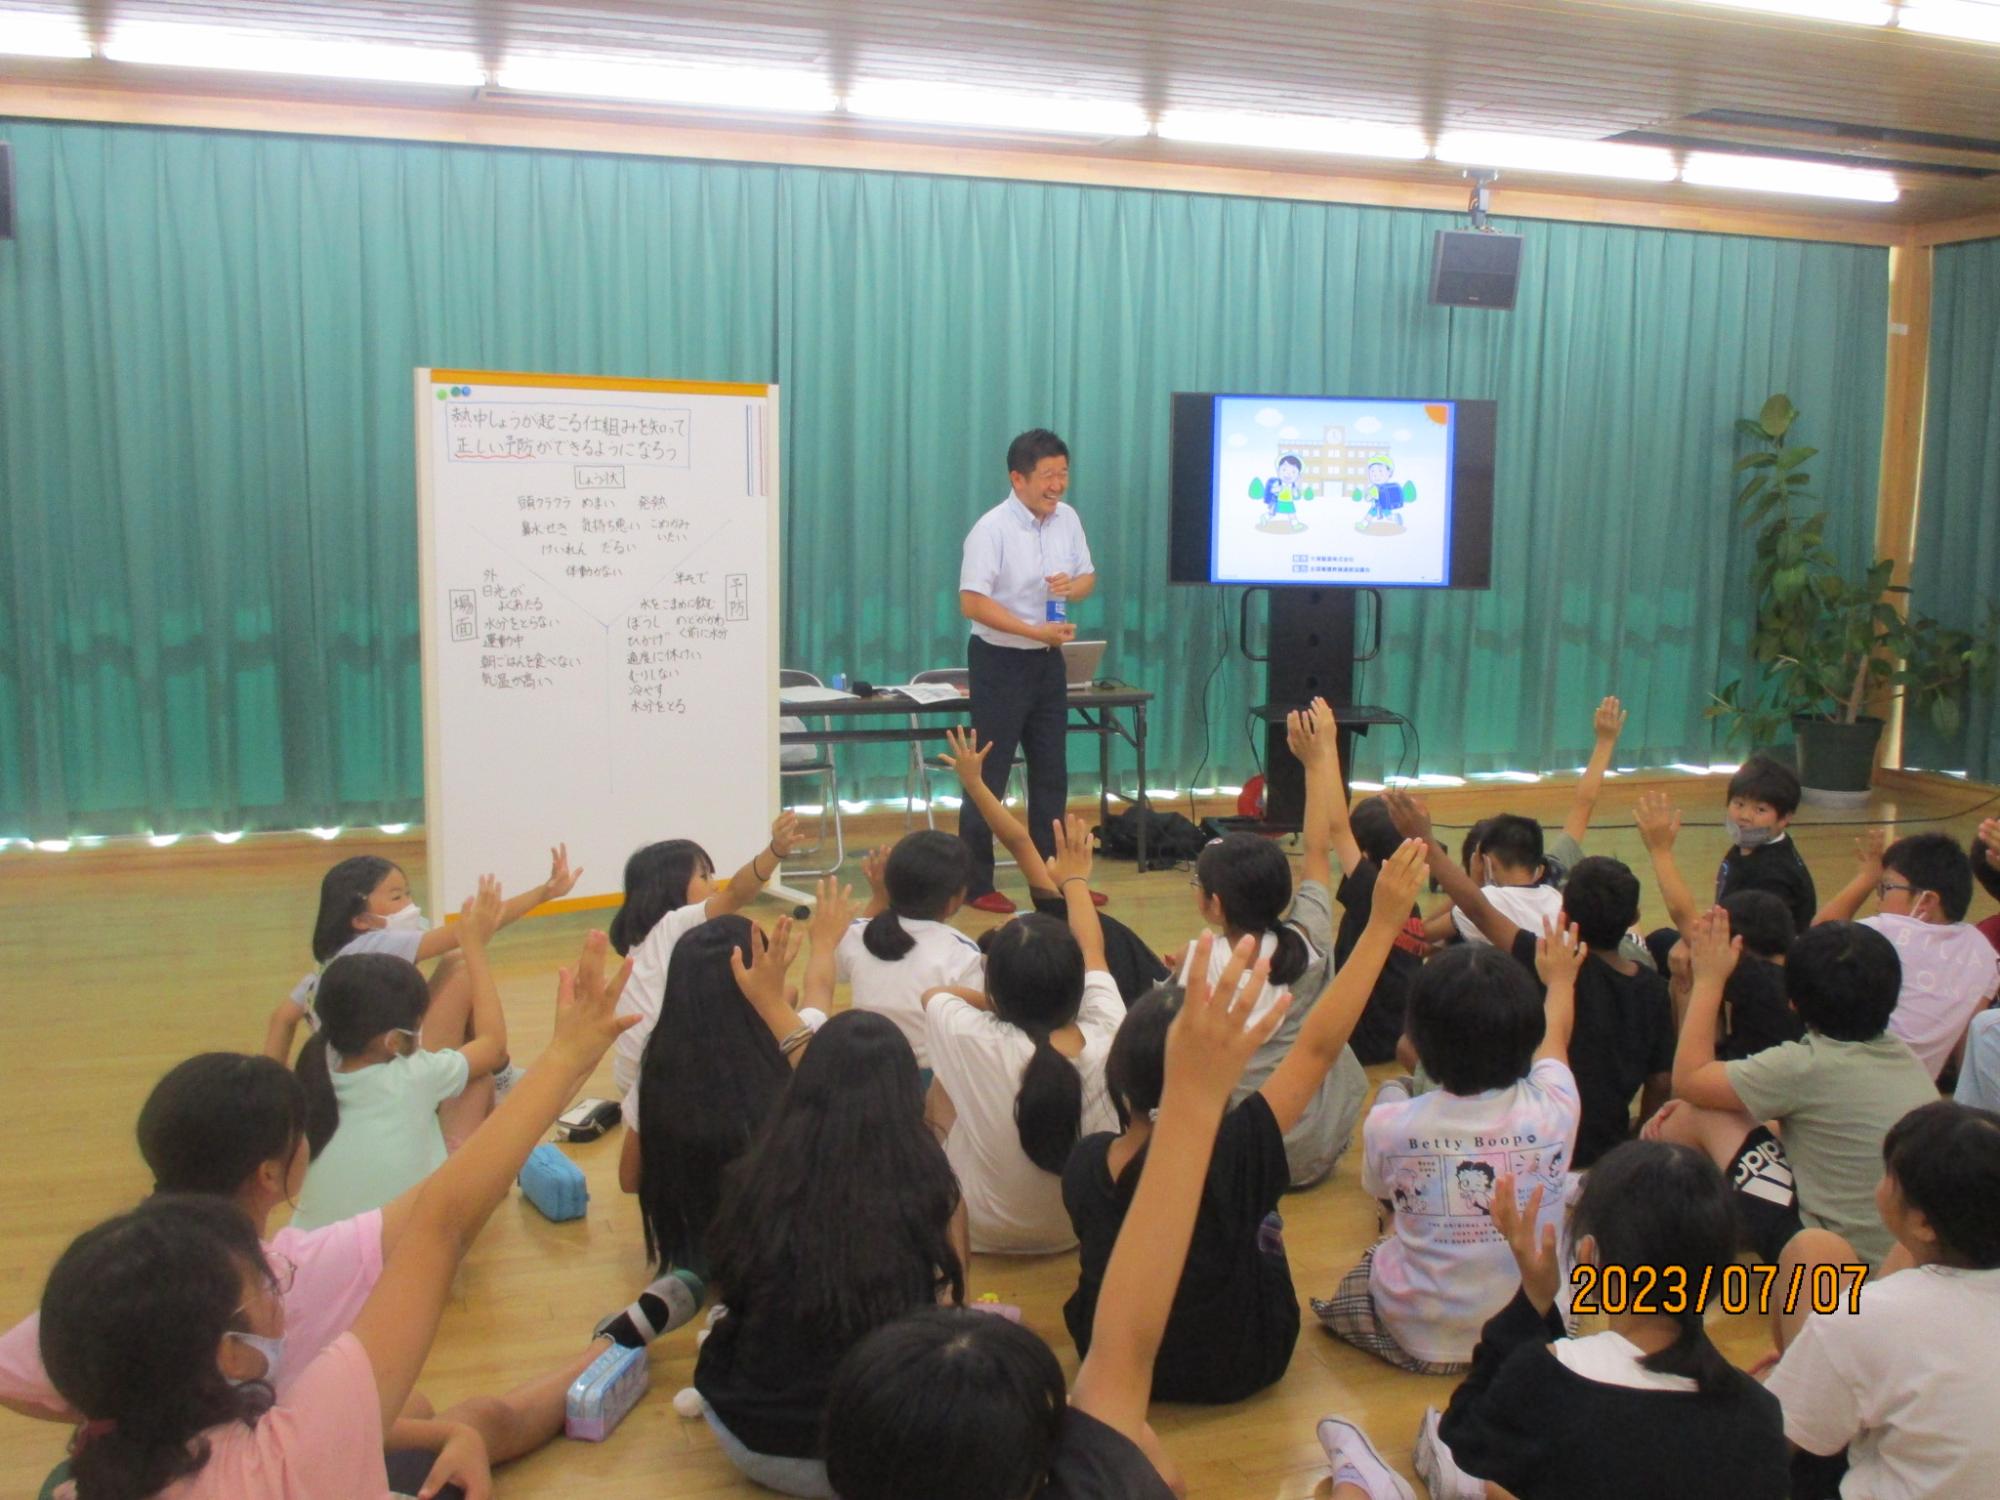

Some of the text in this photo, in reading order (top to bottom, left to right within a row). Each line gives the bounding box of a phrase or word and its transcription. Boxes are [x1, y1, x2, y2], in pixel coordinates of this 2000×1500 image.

[518, 495, 668, 511] 頭クラクラ めまい 発熱
[541, 539, 638, 556] けいれん だるい
[729, 577, 745, 617] 予防
[454, 593, 474, 638] 場面
[1409, 1134, 1522, 1151] Betty Boop
